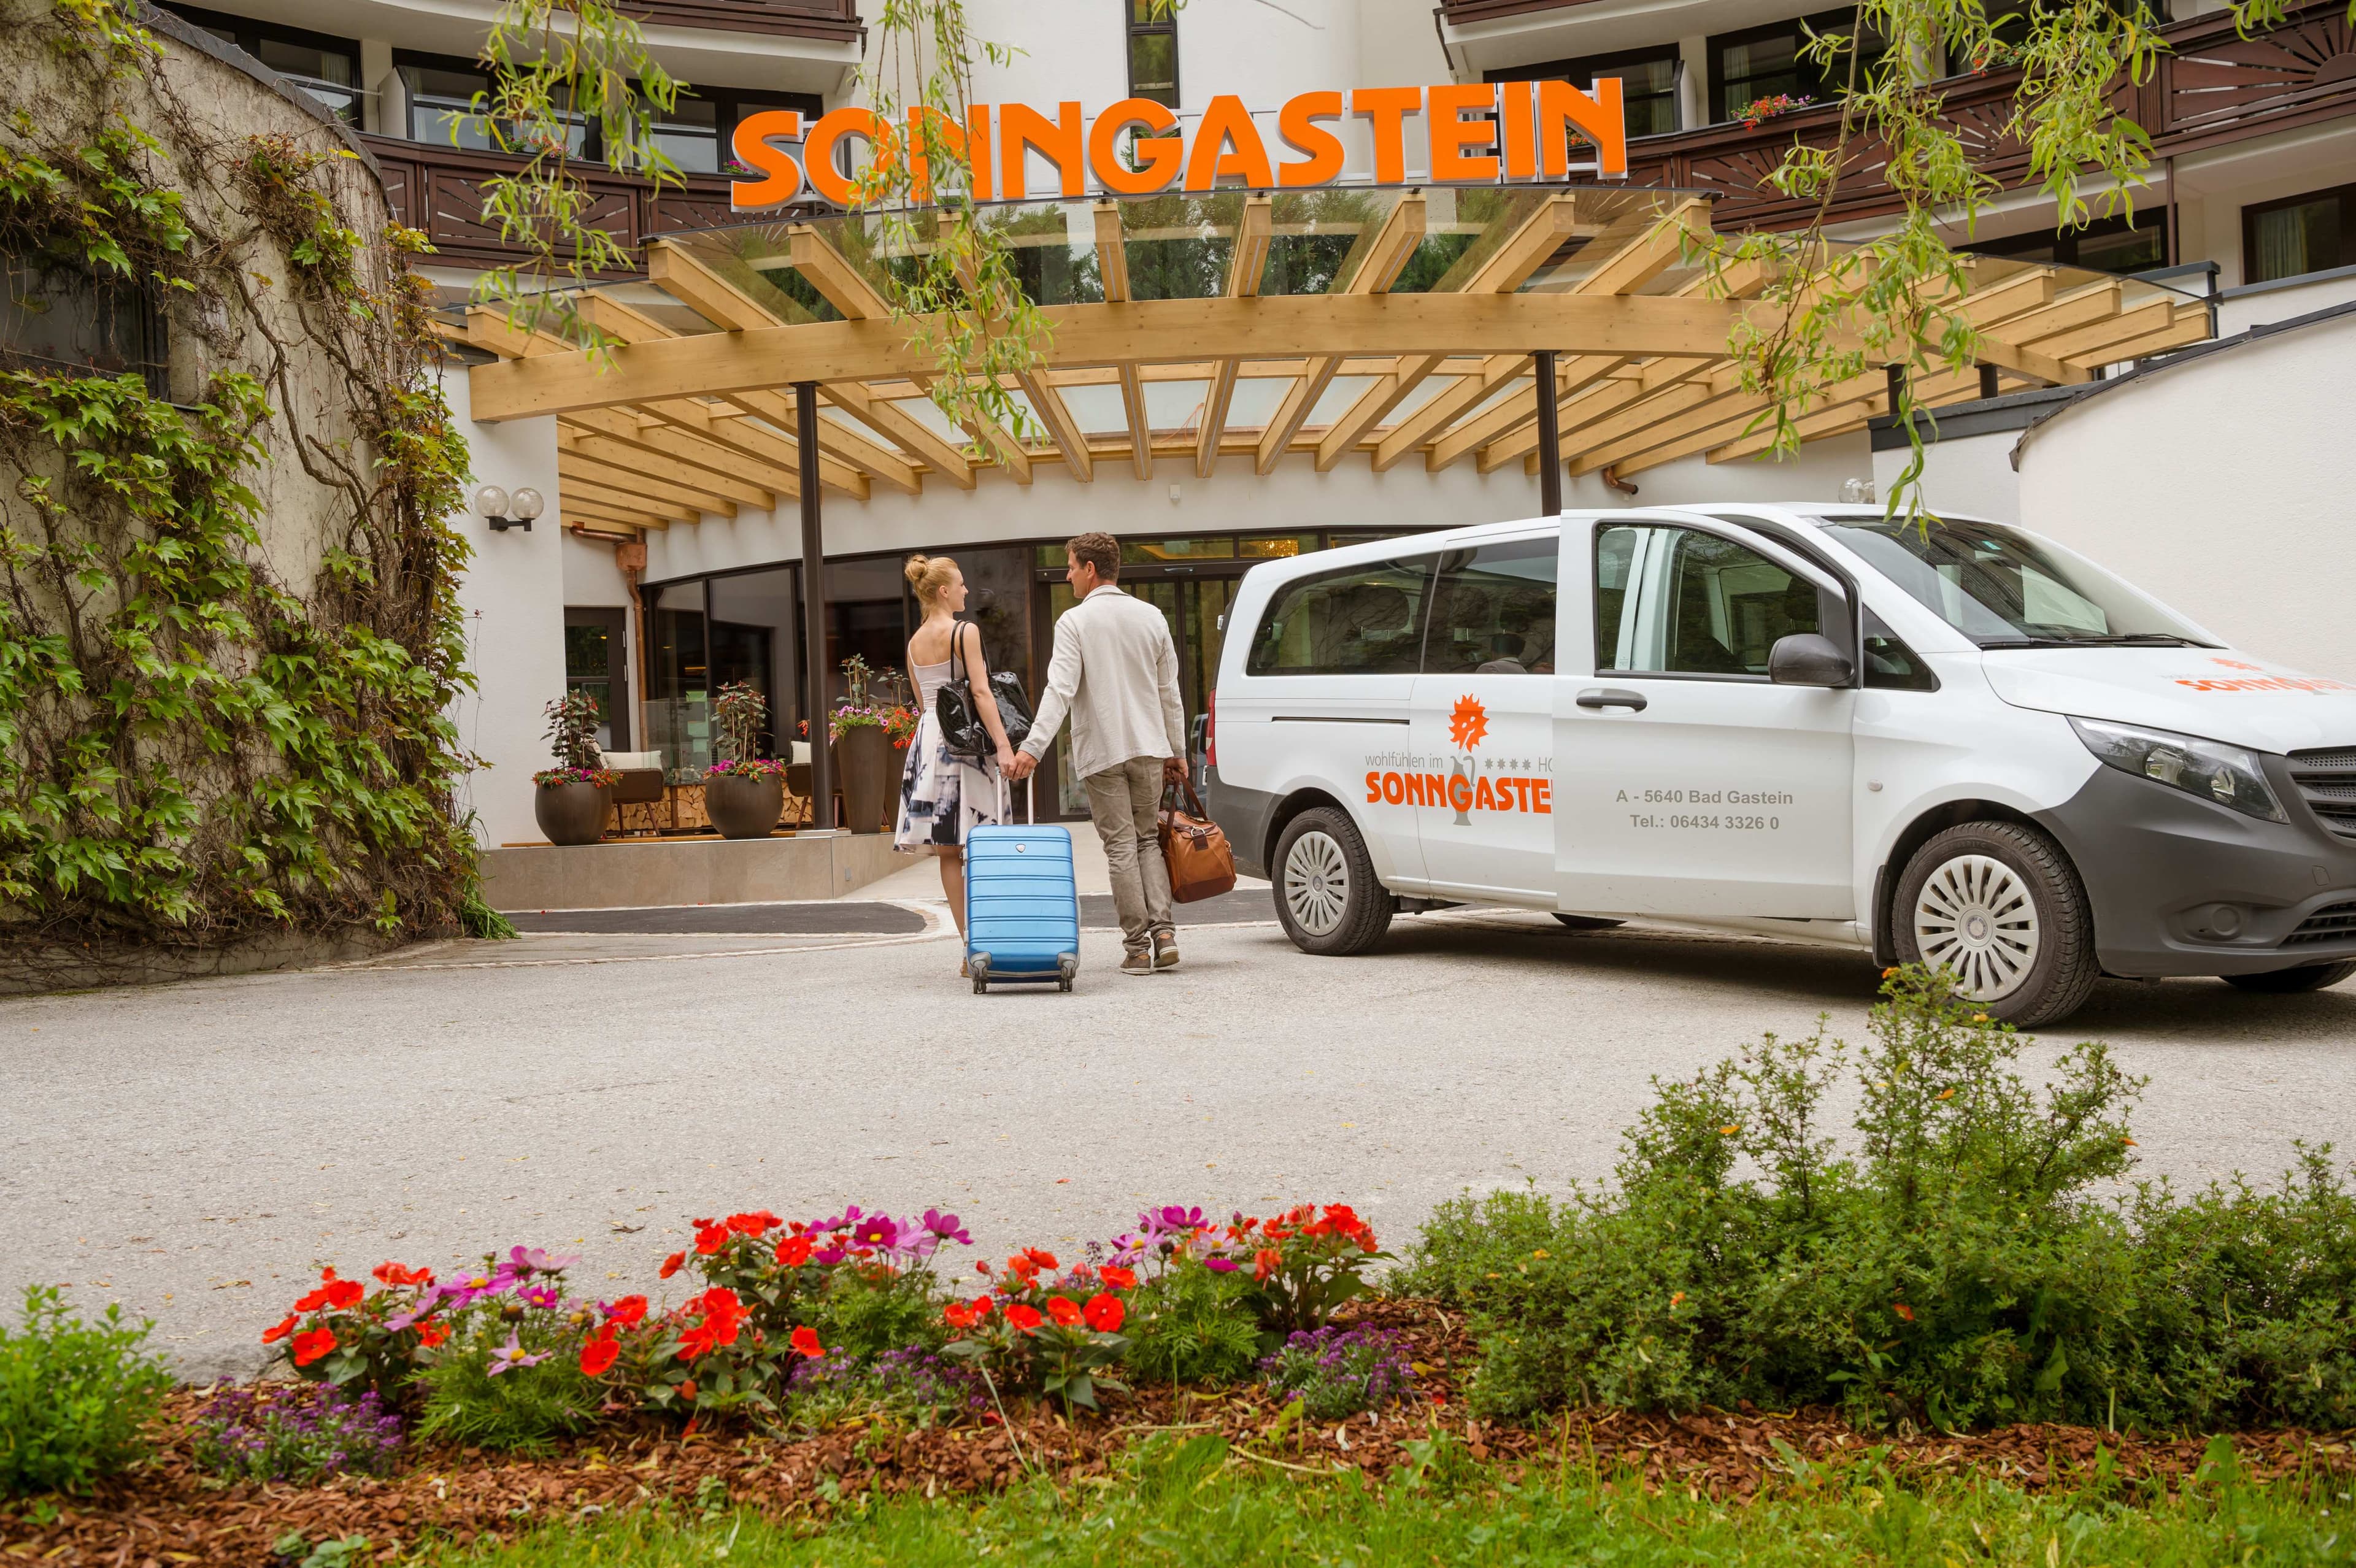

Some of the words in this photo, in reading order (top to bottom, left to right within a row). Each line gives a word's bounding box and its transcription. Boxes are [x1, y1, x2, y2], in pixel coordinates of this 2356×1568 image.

[731, 77, 1627, 211] SONNGASTEIN
[1365, 751, 1425, 768] wohlfühlen
[1429, 753, 1443, 768] im
[1365, 771, 1553, 814] SONNGASTE
[1615, 790, 1629, 802] A
[1644, 790, 1683, 803] 5640
[1688, 790, 1722, 804] Bad
[1727, 791, 1793, 804] Gastein
[1630, 815, 1664, 828] Tel.:
[1670, 815, 1719, 828] 06434
[1725, 816, 1765, 829] 3326
[1769, 817, 1779, 829] 0
